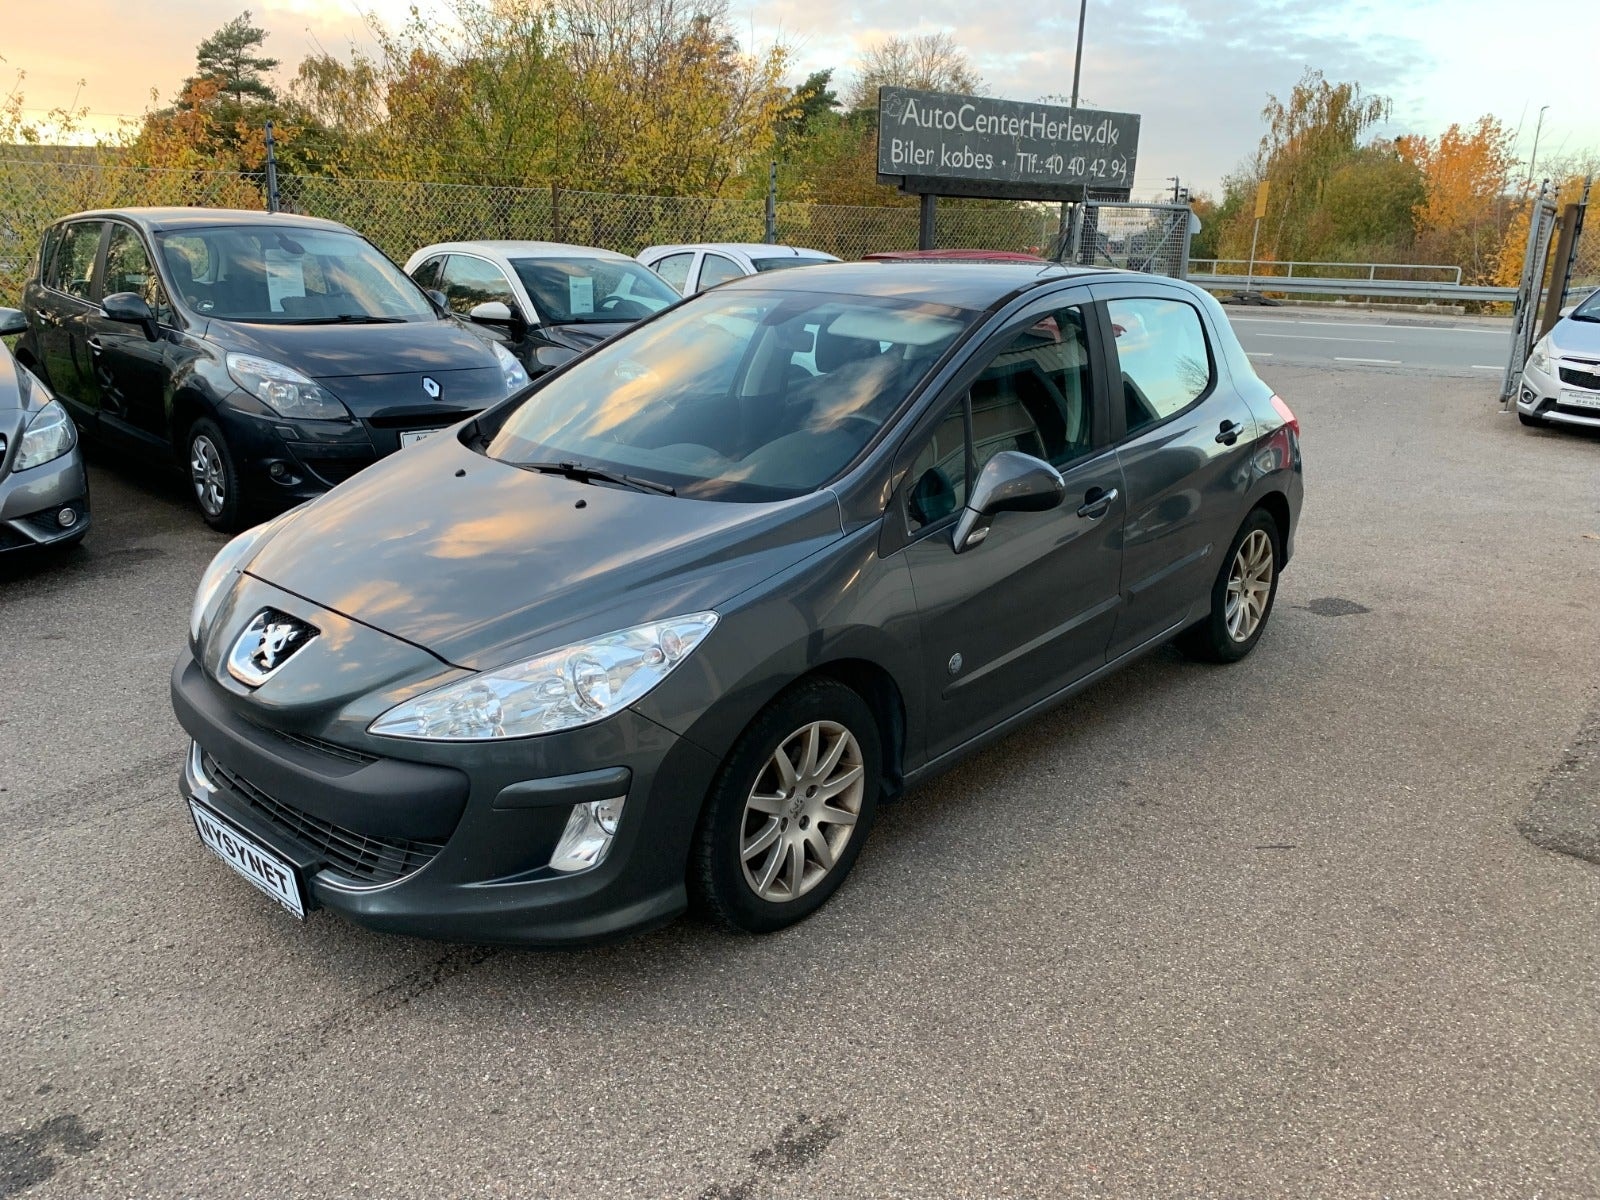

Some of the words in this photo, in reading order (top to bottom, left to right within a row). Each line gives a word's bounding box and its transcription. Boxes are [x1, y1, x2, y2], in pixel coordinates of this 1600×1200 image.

[901, 98, 1119, 145] AutoCenterHerlev.dk
[891, 138, 934, 165] Biler
[941, 143, 993, 170] købes
[1068, 156, 1085, 176] 40
[1089, 158, 1106, 178] 42
[1112, 159, 1127, 179] 94
[198, 815, 288, 895] NYSYNET
